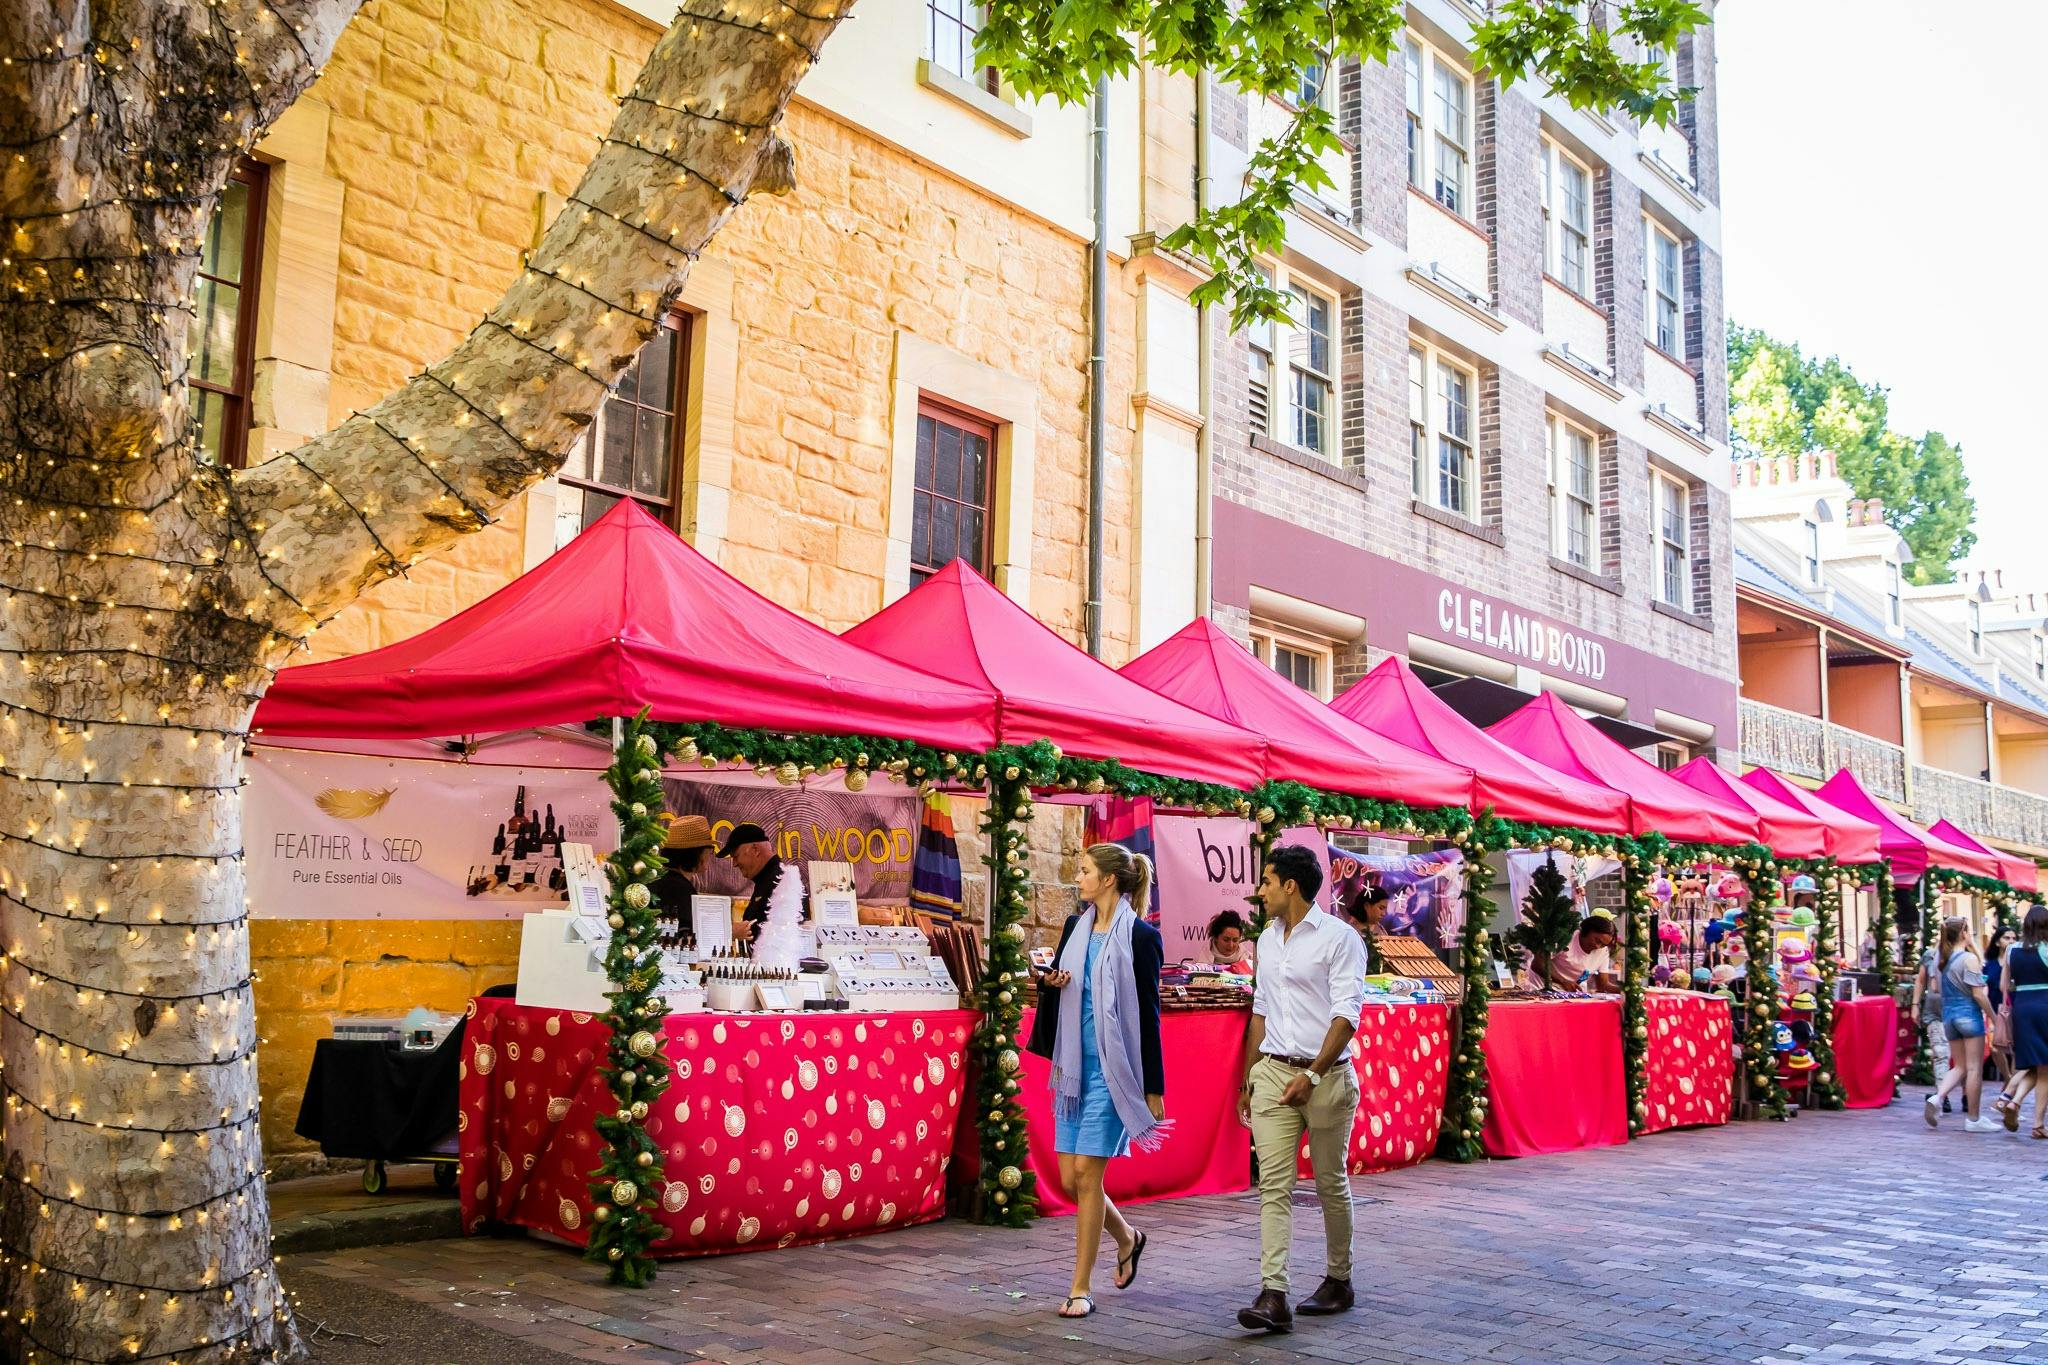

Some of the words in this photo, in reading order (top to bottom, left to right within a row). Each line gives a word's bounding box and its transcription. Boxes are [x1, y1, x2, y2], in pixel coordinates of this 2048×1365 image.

[1438, 588, 1545, 662] CLELAND
[1546, 626, 1607, 681] BOND
[274, 833, 352, 860] FEATHER
[362, 837, 372, 861] &
[381, 837, 423, 863] SEED
[776, 822, 801, 859] in
[811, 823, 913, 864] WOOD
[292, 869, 321, 883] Pure
[325, 870, 378, 885] Essential
[381, 871, 402, 885] Oils
